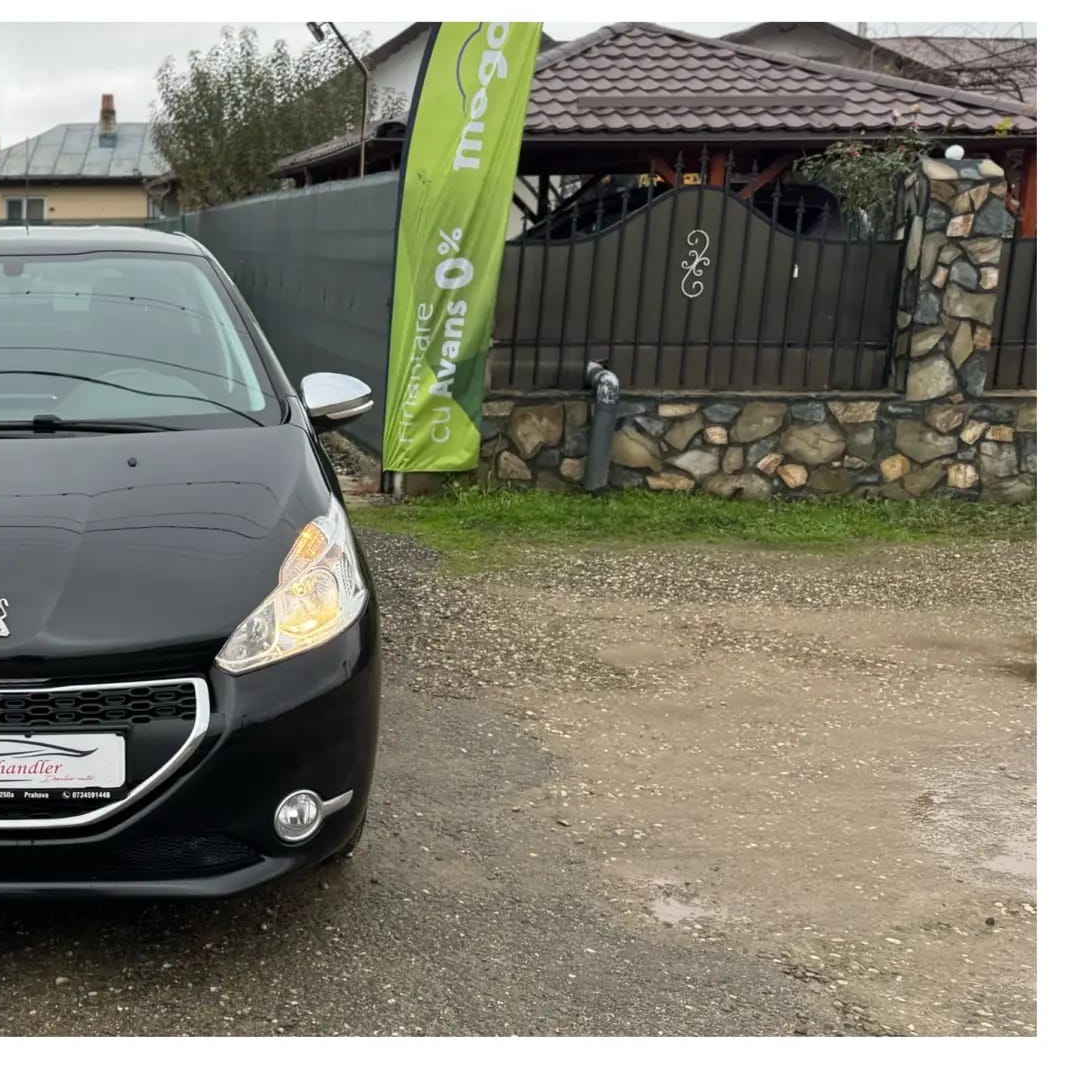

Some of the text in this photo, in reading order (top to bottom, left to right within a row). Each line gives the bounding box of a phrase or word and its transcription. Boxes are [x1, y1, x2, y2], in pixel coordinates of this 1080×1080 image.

[453, 22, 509, 171] mogo
[429, 227, 474, 444] cu Avans 0%
